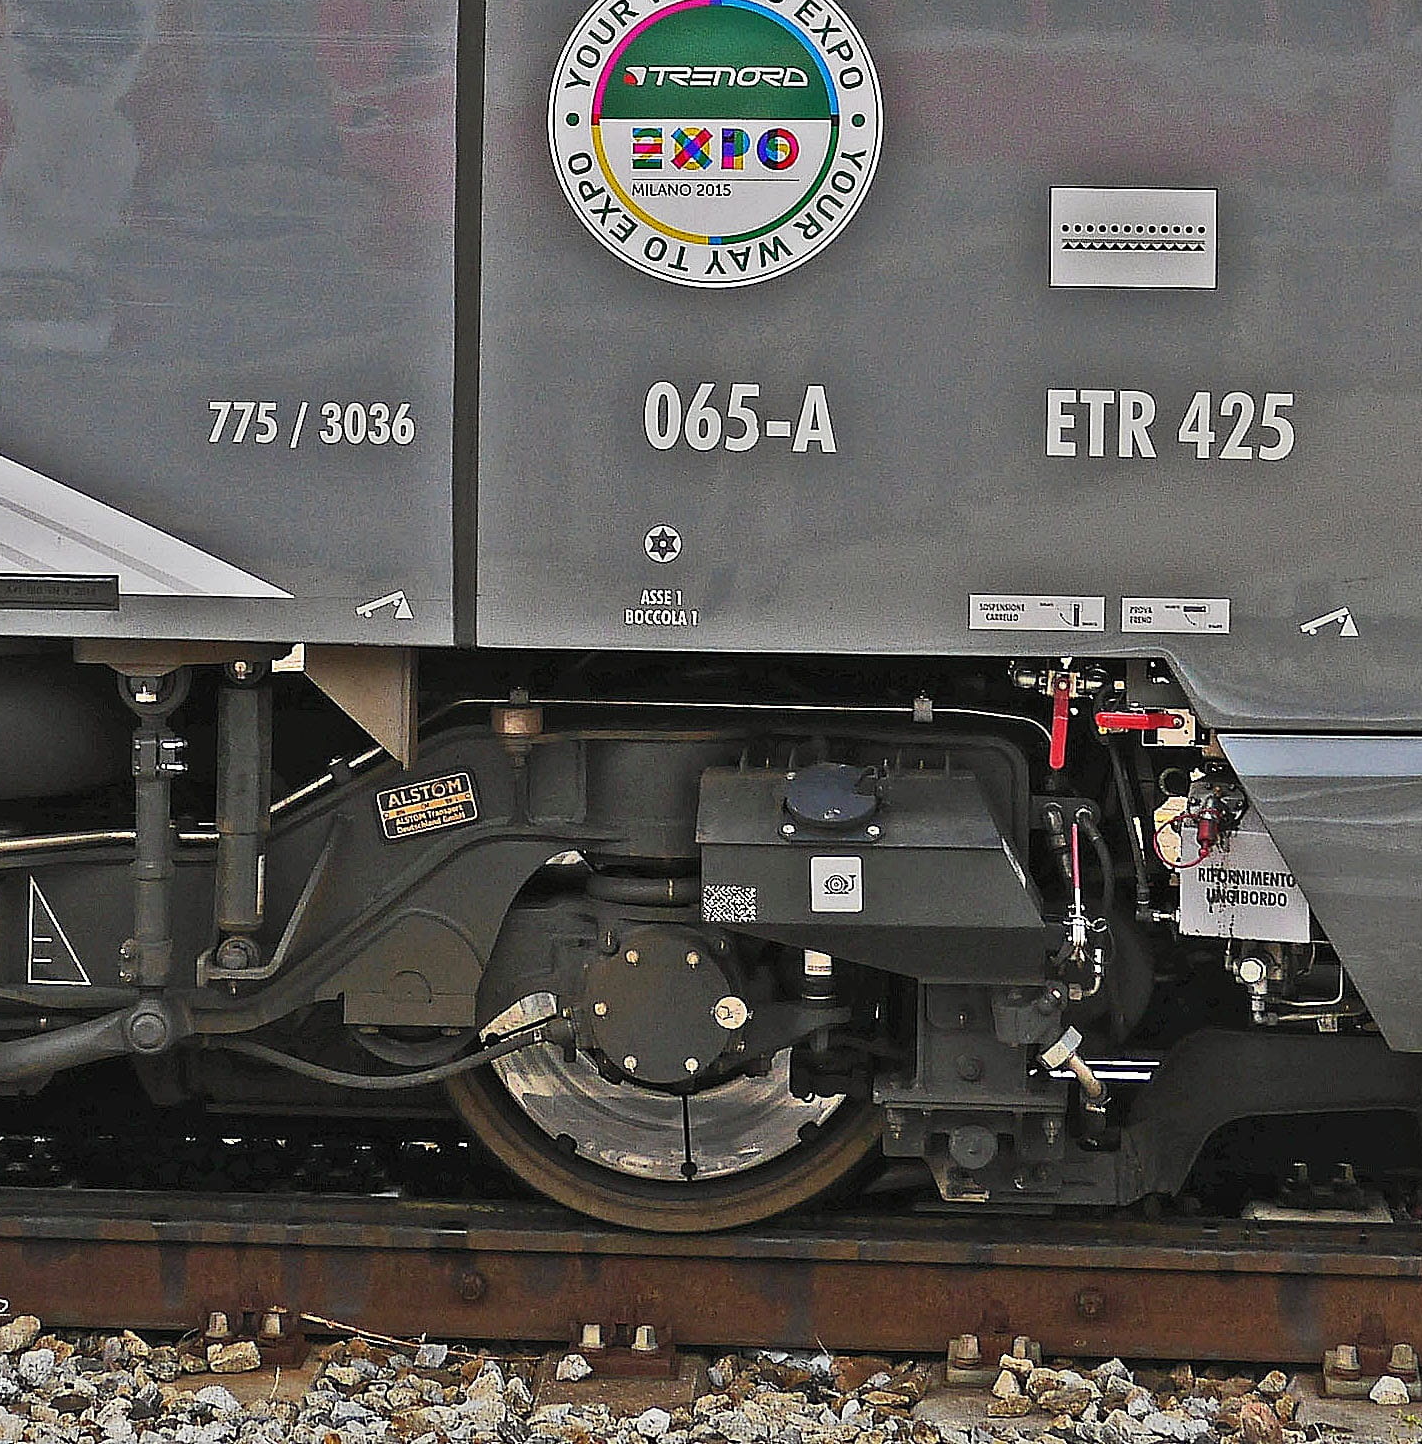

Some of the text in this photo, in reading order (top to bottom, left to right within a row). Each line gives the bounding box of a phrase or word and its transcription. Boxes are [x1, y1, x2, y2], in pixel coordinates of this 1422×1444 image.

[647, 65, 809, 87] TRENORD
[631, 126, 800, 171] EXPO
[631, 183, 732, 197] MILANO 2015
[568, 150, 868, 276] YOUR WAY TO EXPO
[207, 401, 278, 444] 775
[319, 402, 416, 445] 3036
[643, 381, 838, 454] 065-A
[1046, 388, 1296, 461] ETR 425
[640, 589, 683, 606] ASSE 1
[624, 608, 699, 626] BOCCOLA 1
[388, 778, 463, 808] ALSTOM
[1197, 866, 1297, 888] RIFORNIMENTO
[1206, 887, 1288, 907] UNGIBORDO
